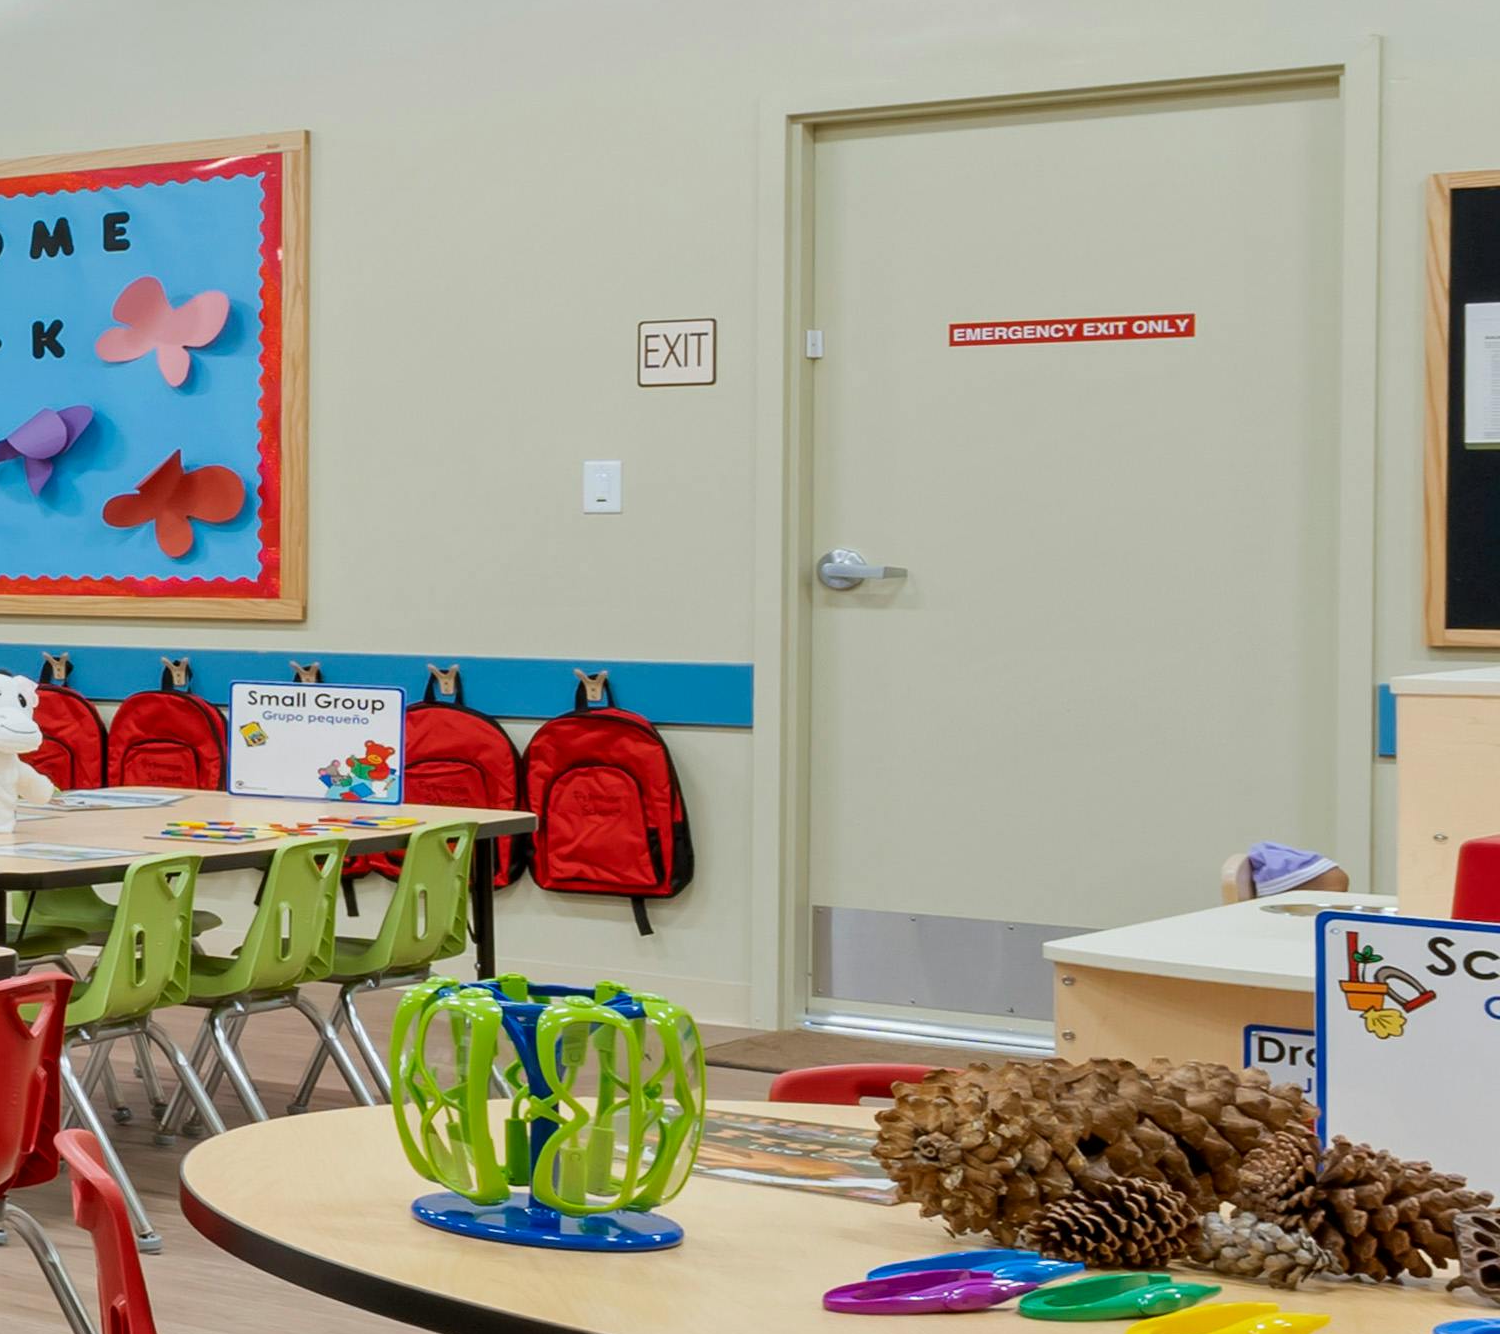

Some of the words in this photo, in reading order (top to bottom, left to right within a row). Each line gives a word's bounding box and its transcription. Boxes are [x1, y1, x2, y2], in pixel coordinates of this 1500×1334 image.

[953, 324, 1077, 342] EMERGENCY
[1082, 320, 1127, 337] EXIT
[1132, 318, 1189, 334] ONLY
[644, 332, 709, 368] EXIT
[247, 690, 306, 708] Small
[315, 693, 385, 714] Group
[262, 710, 304, 723] Grupo
[308, 713, 369, 726] pequeño
